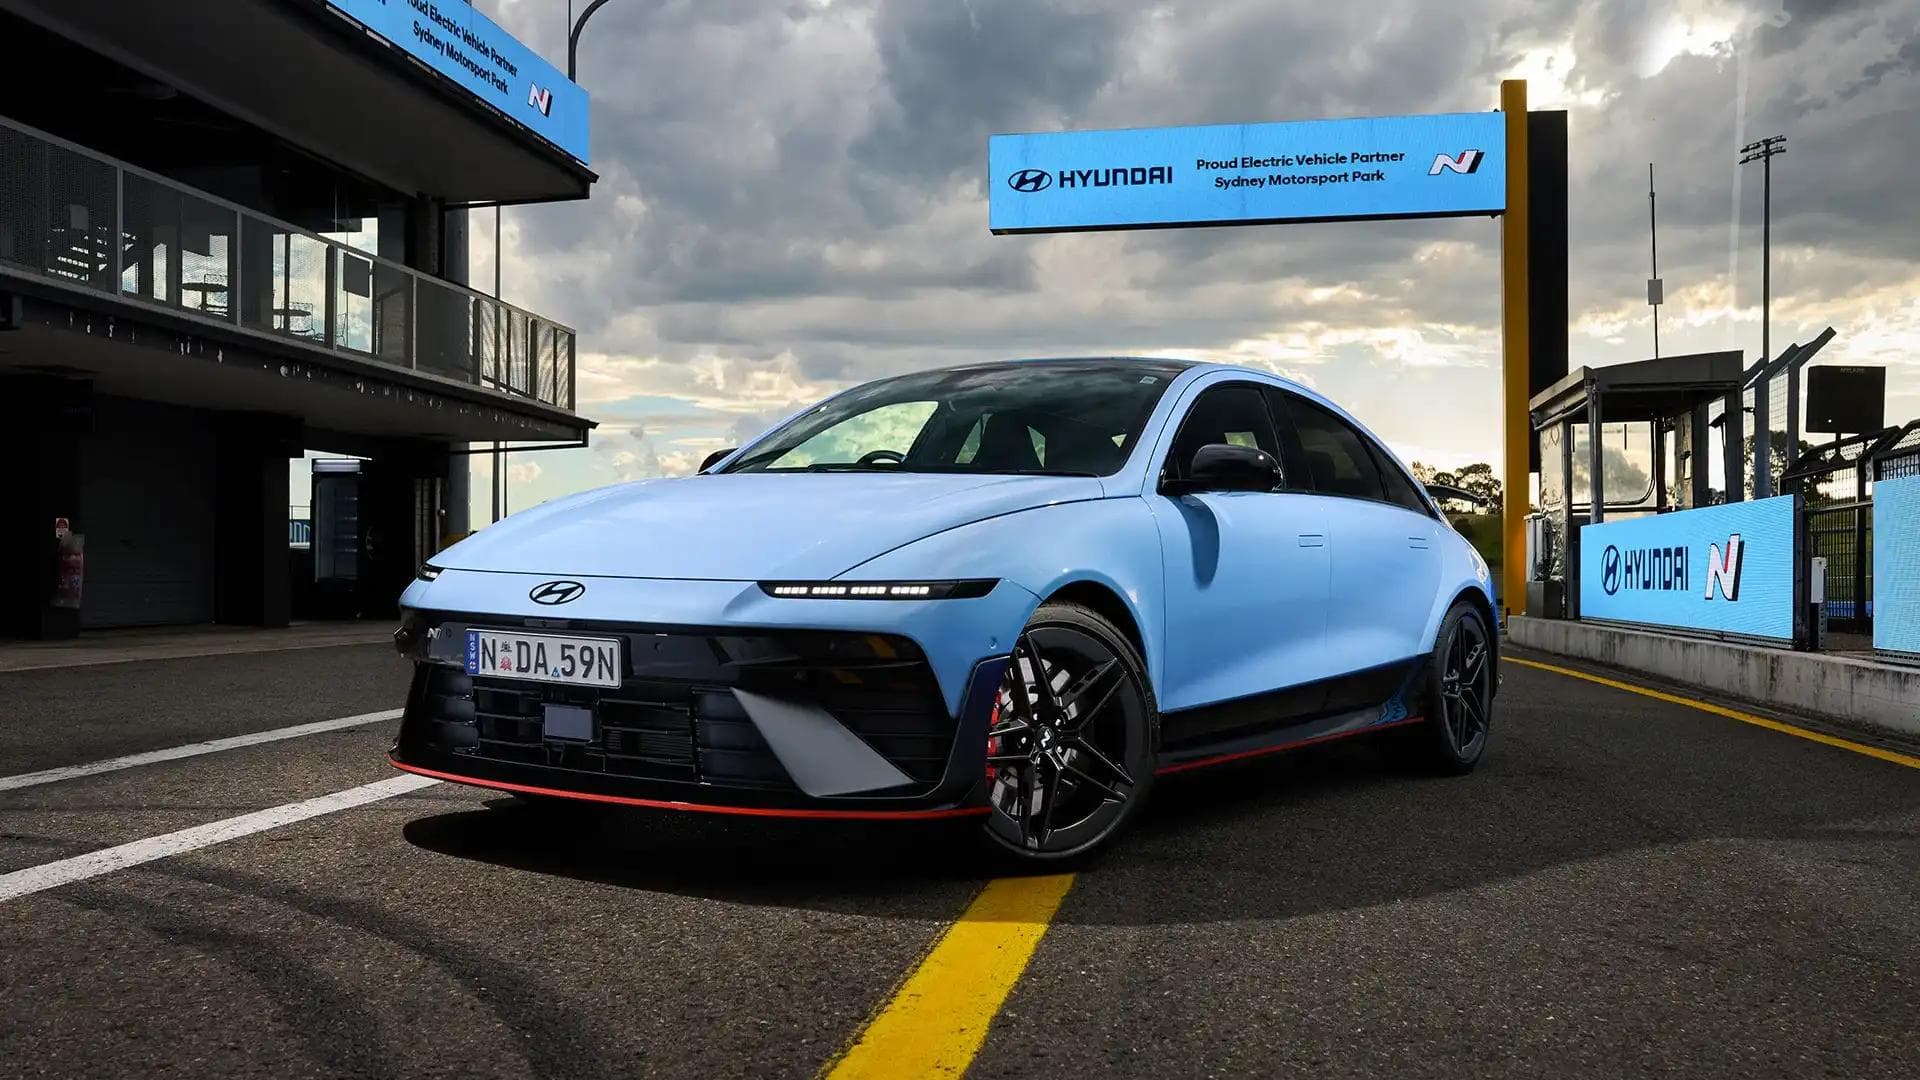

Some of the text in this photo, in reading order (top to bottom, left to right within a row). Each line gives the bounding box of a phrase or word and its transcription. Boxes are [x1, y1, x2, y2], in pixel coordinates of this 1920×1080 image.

[413, 20, 509, 96] Sydney Motorsport Park
[429, 4, 461, 38] Electric
[461, 26, 490, 58] Vehicle
[490, 47, 518, 78] Partner
[1059, 166, 1173, 189] HYUNDAI
[1196, 151, 1405, 171] Proud Electric Vehicle Partner
[1214, 169, 1385, 191] Sydney Motorsport Park
[1624, 546, 1689, 591] HYUNDAI
